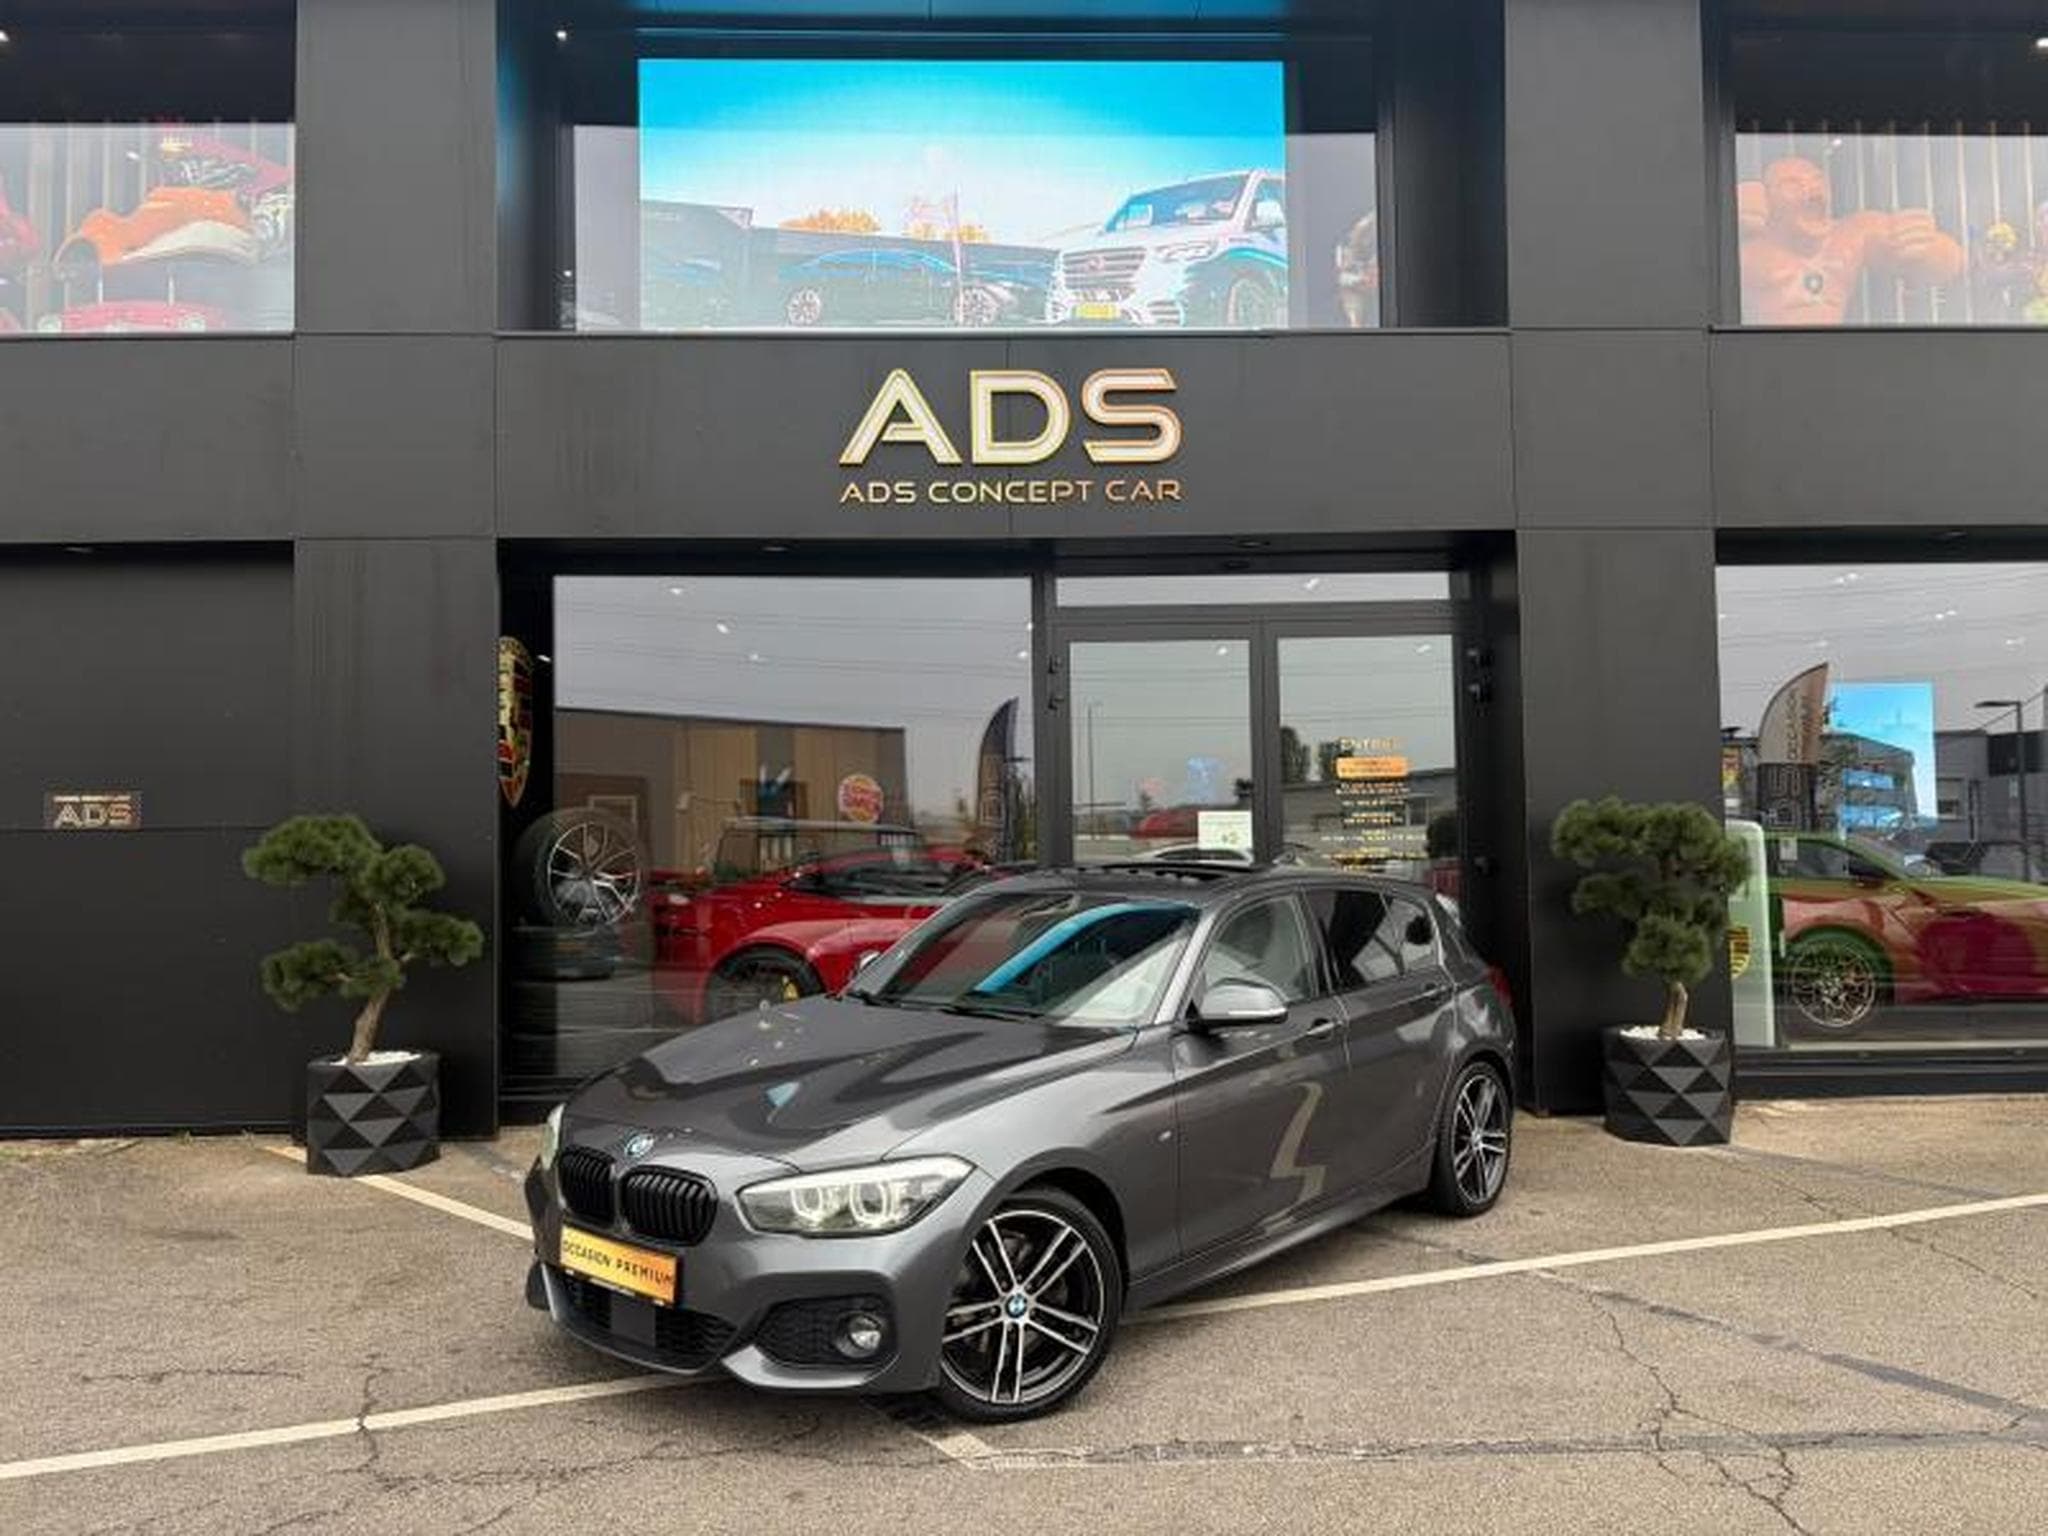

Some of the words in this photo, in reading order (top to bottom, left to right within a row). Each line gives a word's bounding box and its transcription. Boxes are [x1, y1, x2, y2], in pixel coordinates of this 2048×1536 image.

[839, 367, 1183, 465] ADS
[839, 481, 917, 503] ADS
[928, 479, 1094, 504] CONCEPT
[1104, 479, 1182, 501] CAR
[53, 803, 133, 829] ADS
[562, 1239, 612, 1268] OCCASION
